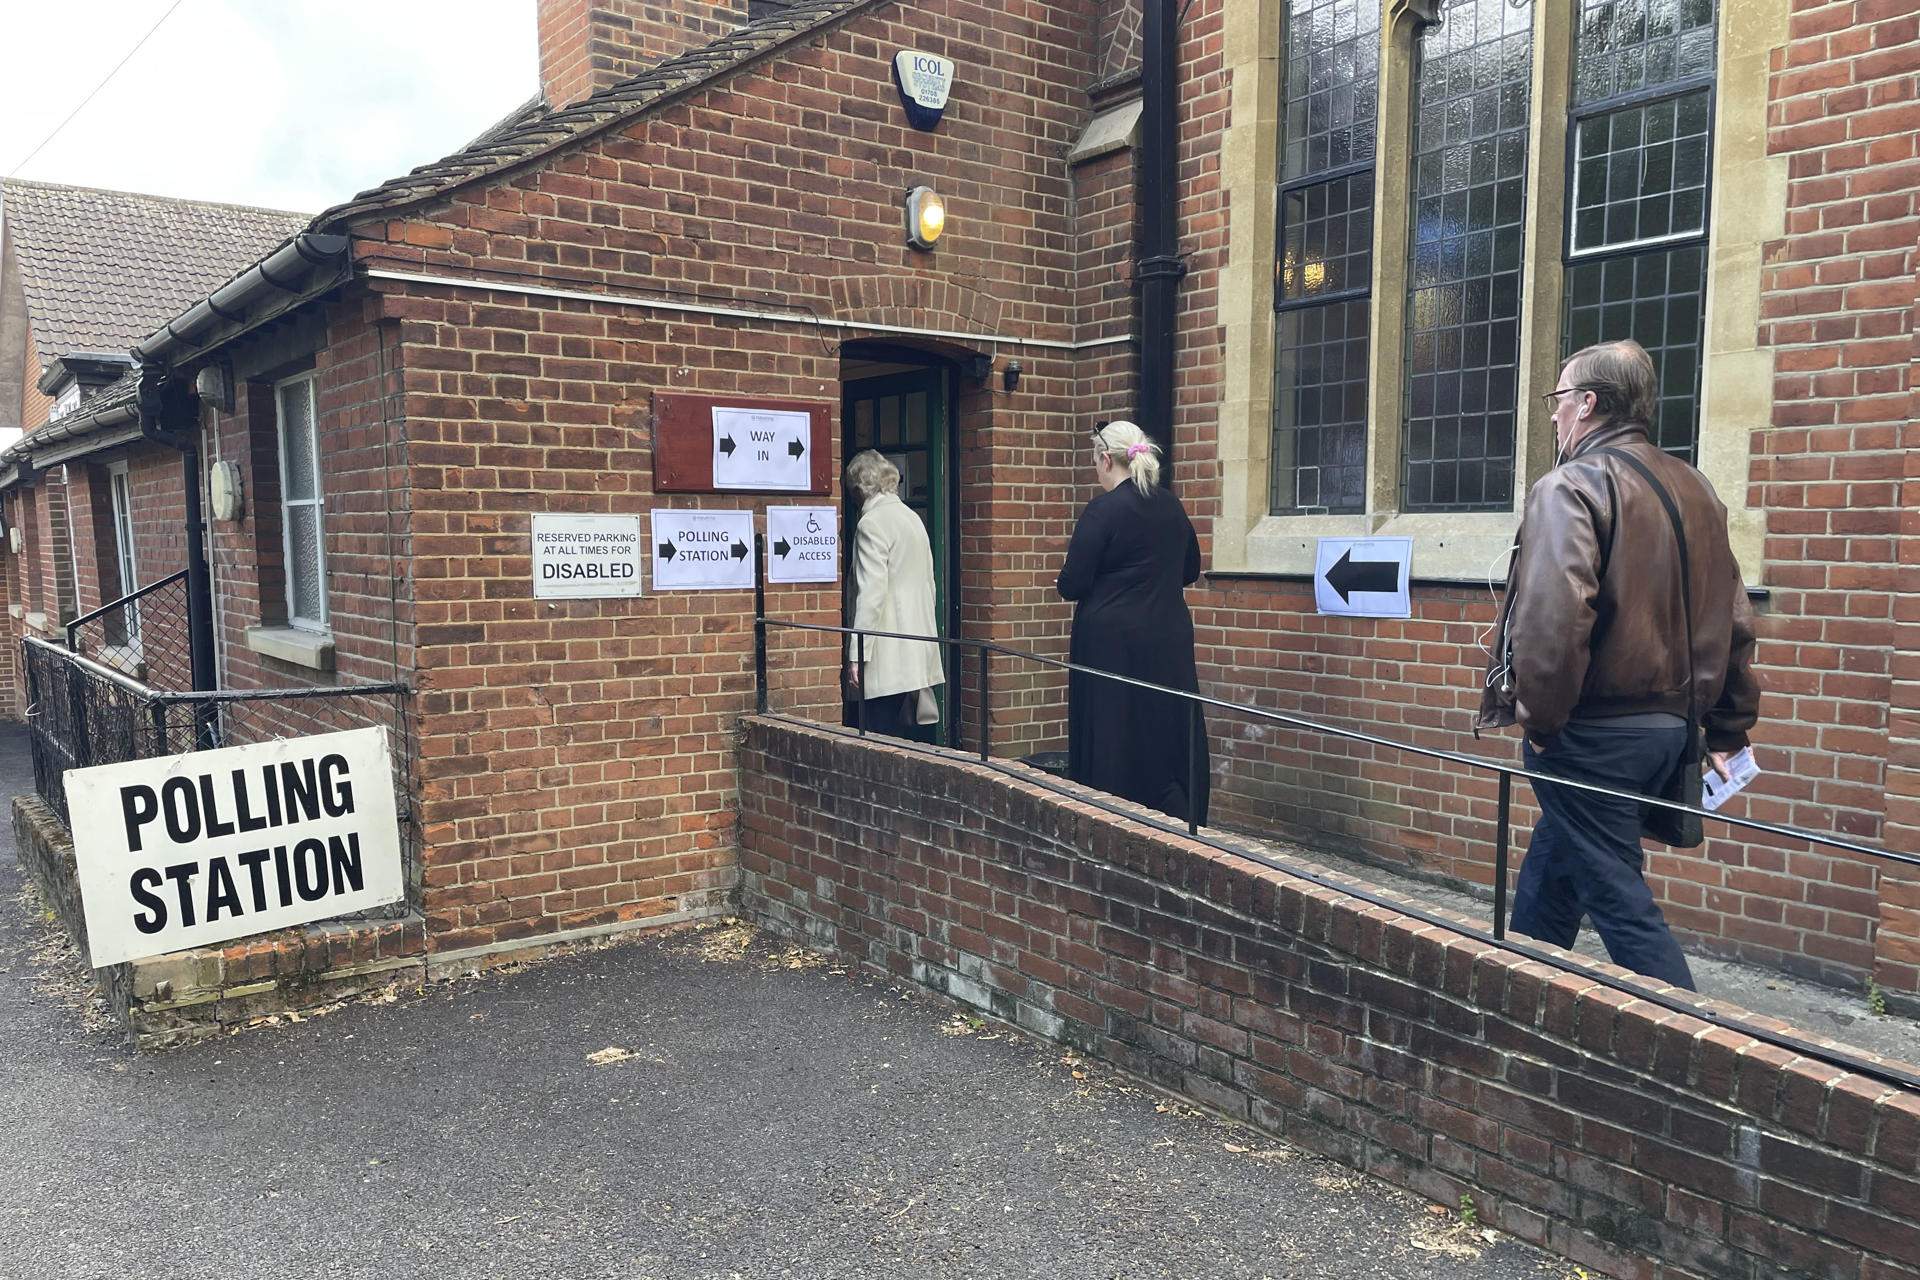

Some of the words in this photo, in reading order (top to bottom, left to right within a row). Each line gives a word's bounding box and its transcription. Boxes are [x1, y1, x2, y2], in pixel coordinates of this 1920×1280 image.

[914, 56, 944, 76] ICOL
[750, 430, 775, 442] WAY
[757, 450, 769, 461] IN
[537, 533, 591, 542] RESERVED
[593, 533, 637, 542] PARKING
[678, 531, 729, 542] POLLING
[793, 536, 836, 546] DISABLED
[543, 546, 556, 555] AT
[558, 546, 577, 555] ALL
[579, 546, 608, 555] TIMES
[611, 546, 631, 555] FOR
[679, 550, 729, 561] STATION
[798, 551, 832, 561] ACCESS
[543, 563, 634, 579] DISABLED
[120, 753, 355, 852] POLLING
[129, 832, 364, 934] STATION
